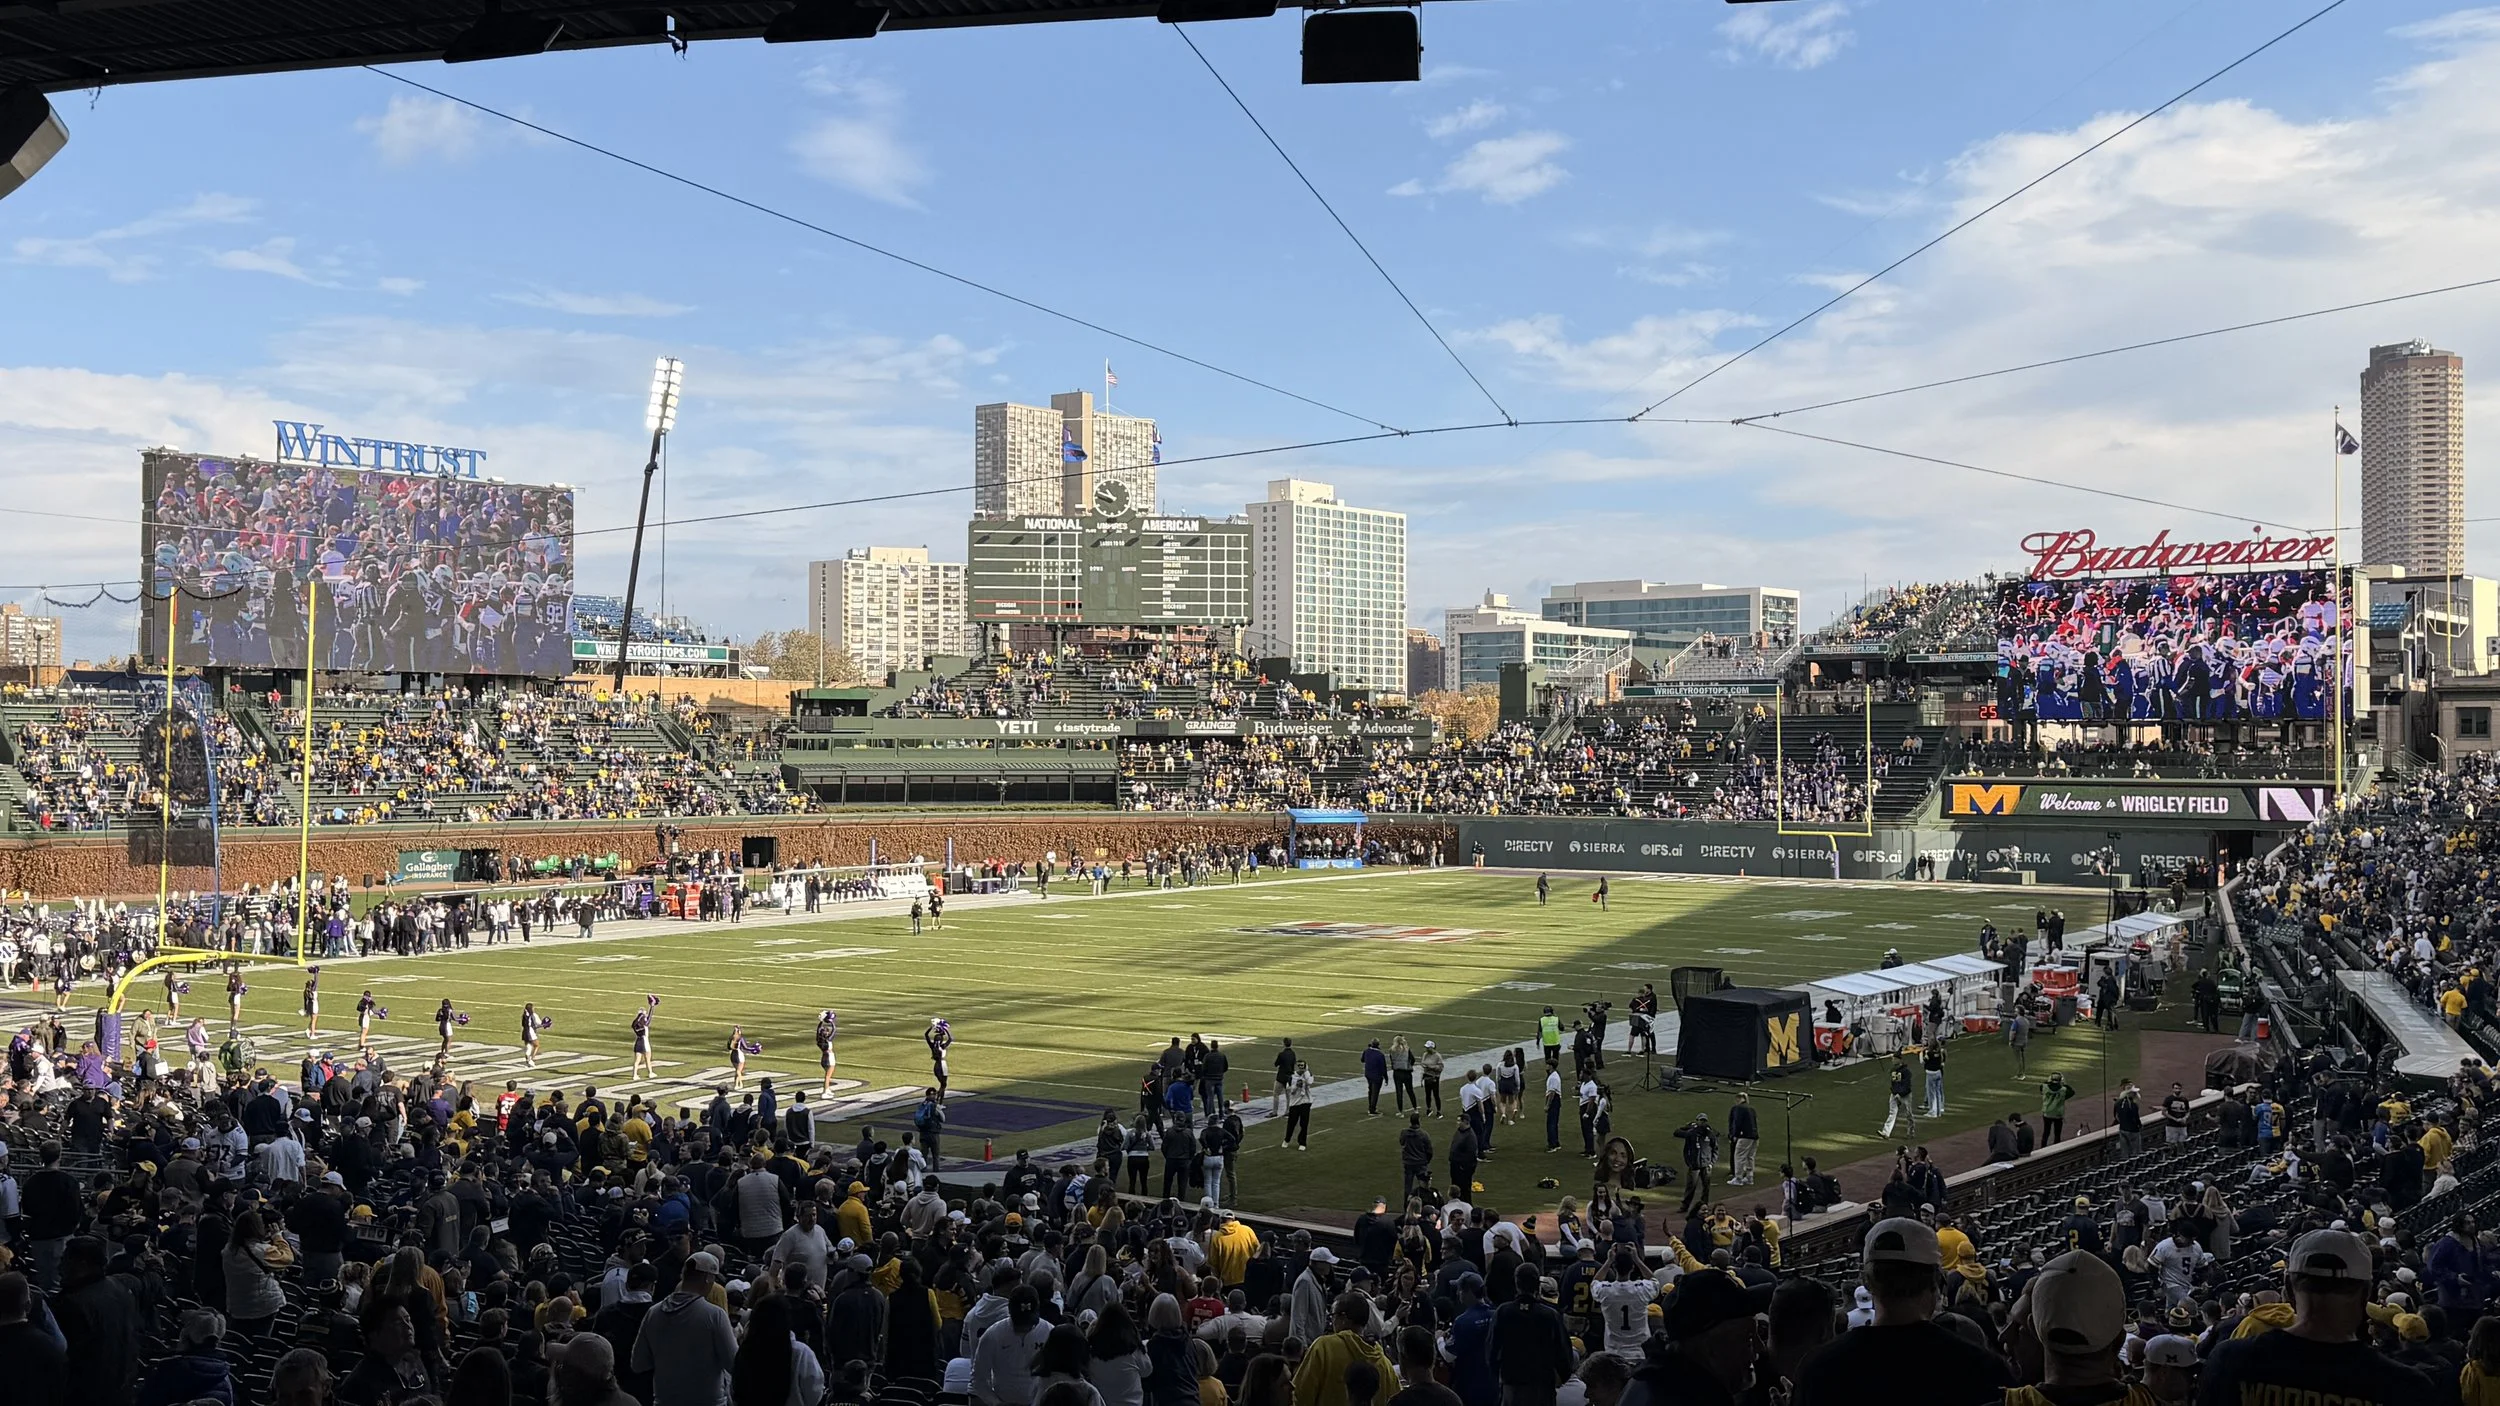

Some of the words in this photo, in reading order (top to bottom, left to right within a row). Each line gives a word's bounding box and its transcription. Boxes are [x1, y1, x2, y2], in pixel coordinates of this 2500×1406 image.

[273, 420, 487, 479] WINTRUST
[1024, 517, 1083, 530] NATIONAL
[1142, 519, 1200, 532] AMERICAN
[2021, 525, 2336, 579] Budweiser
[1653, 686, 1750, 695] WRIGLEYROOFTOPS.COM
[1980, 706, 1998, 719] 25
[996, 720, 1039, 734] YETI
[1062, 722, 1121, 735] tastytrade
[1185, 721, 1237, 731] GRAINGER
[1253, 721, 1333, 735] Budweiser
[1363, 722, 1414, 734] Advocate
[2040, 792, 2102, 812] Welcome
[2121, 796, 2186, 814] WRIGLEY
[2187, 797, 2229, 814] FIELD
[1504, 839, 1554, 852] DIRECTV
[1583, 842, 1624, 853] SIERRA
[1700, 845, 1756, 858] DIRECTV
[1788, 849, 1833, 861] SIERRA
[405, 862, 453, 873] Gallagher
[1766, 1011, 1801, 1068] M
[2182, 1257, 2192, 1275] 5
[1620, 1304, 1631, 1331] 1
[2166, 1353, 2177, 1363] M
